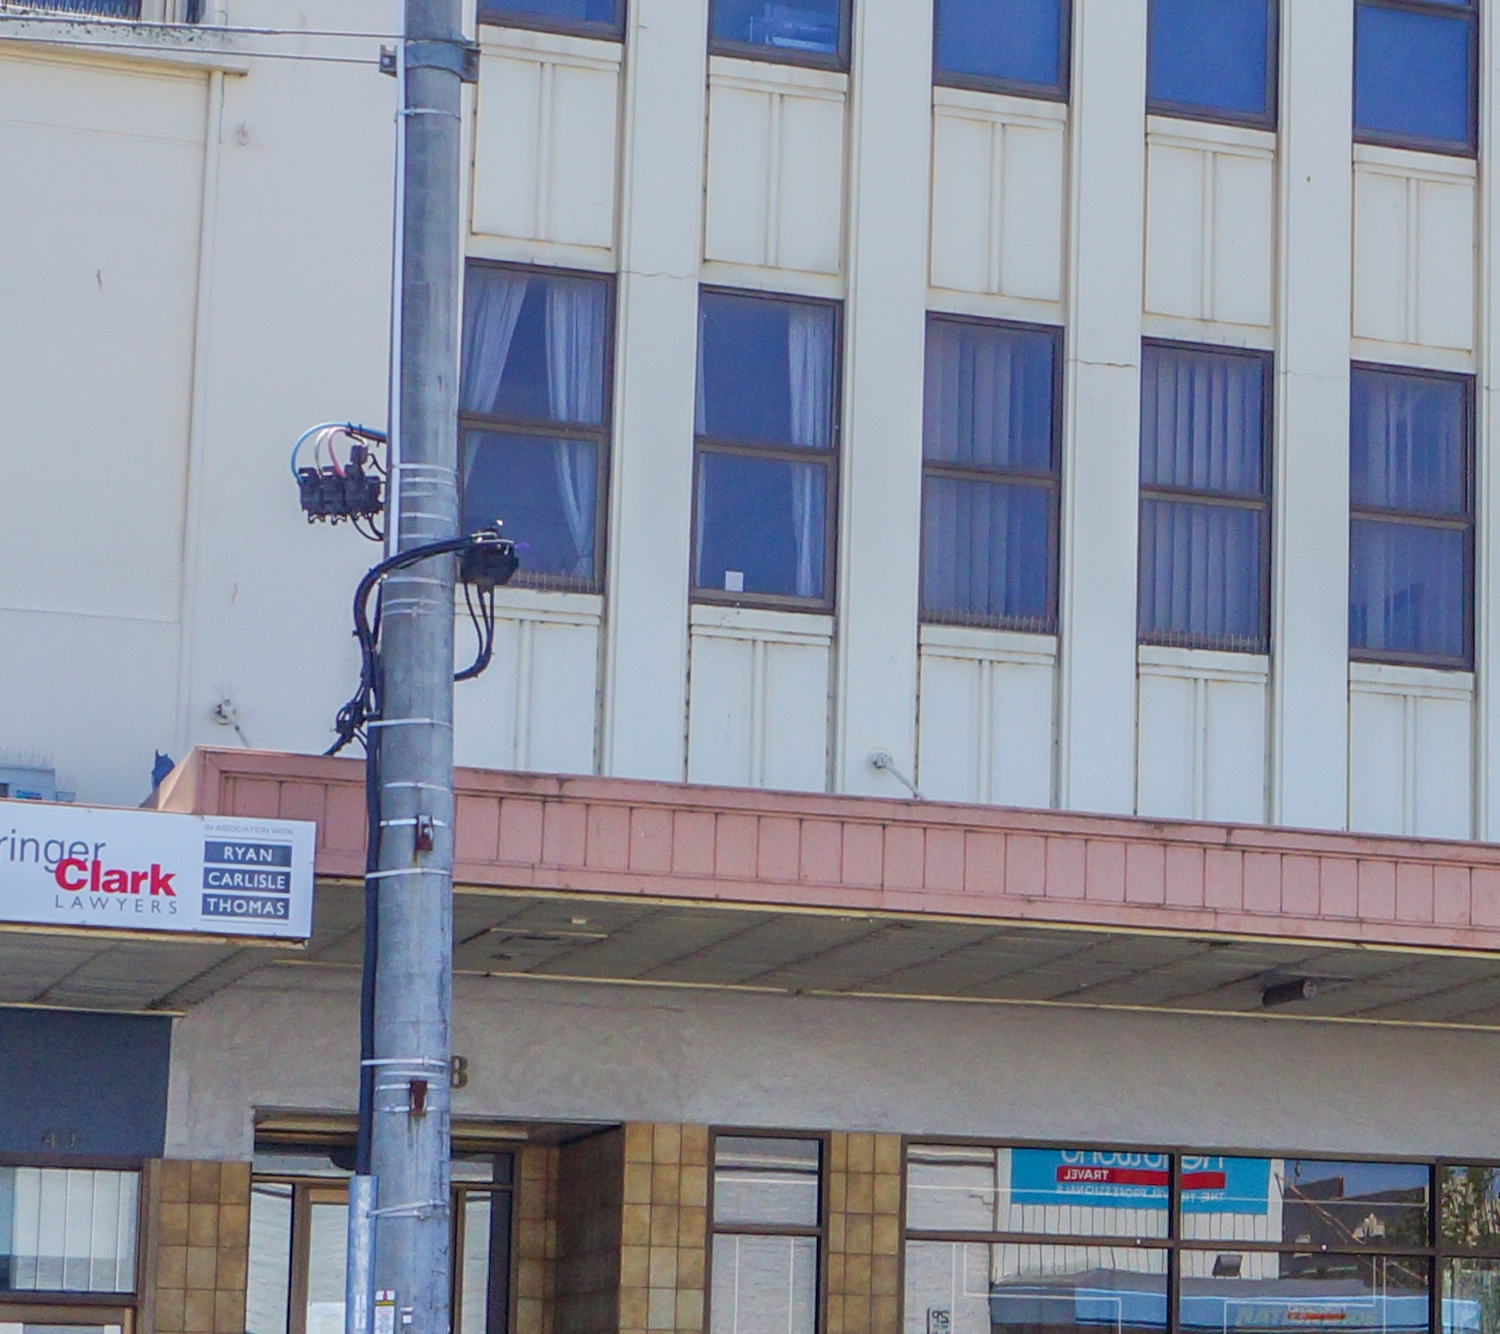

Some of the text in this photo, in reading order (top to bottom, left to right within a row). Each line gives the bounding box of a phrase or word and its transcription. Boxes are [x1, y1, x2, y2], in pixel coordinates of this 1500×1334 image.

[223, 845, 274, 863] RYAN
[54, 857, 177, 898] Clark
[207, 870, 287, 890] CARLISLE
[54, 894, 179, 916] LAWYERS
[205, 897, 286, 917] THOMAS
[449, 1055, 469, 1090] 8
